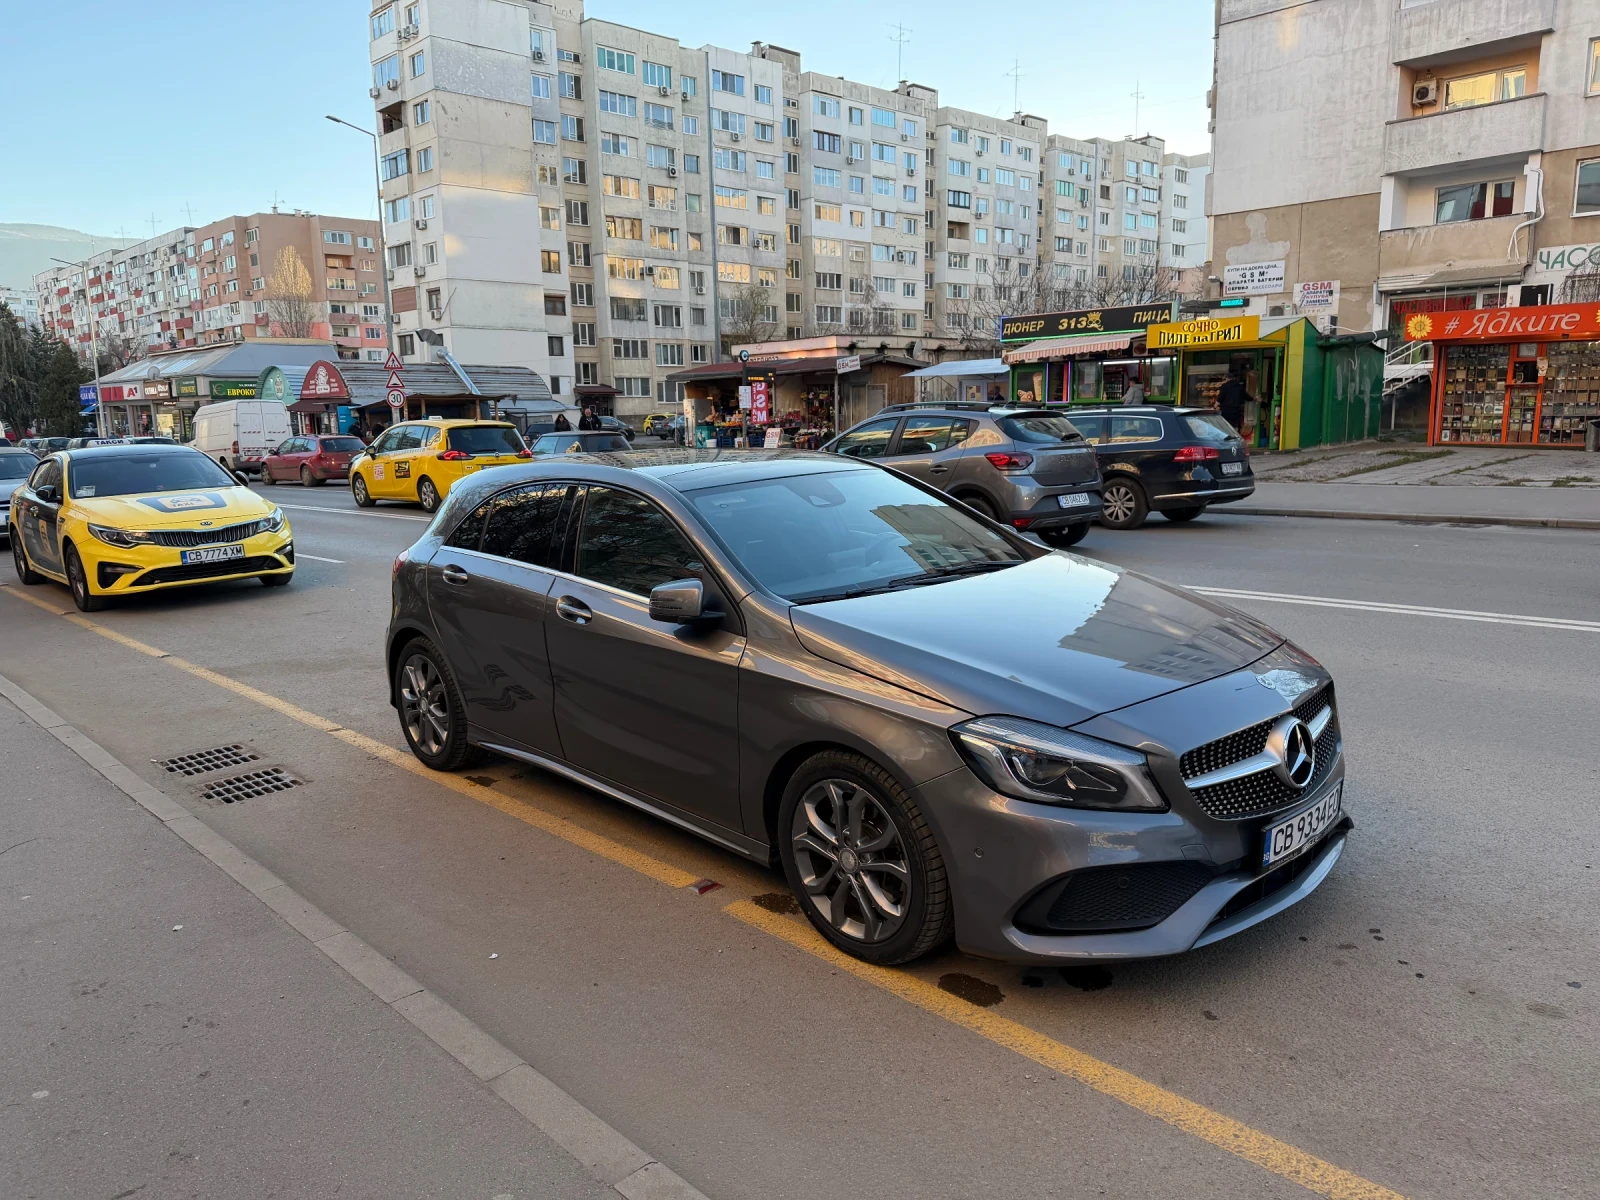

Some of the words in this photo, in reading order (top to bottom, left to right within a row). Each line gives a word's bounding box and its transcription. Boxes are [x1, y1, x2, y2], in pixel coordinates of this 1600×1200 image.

[1302, 282, 1332, 291] GSM
[1133, 309, 1170, 323] ПИЦА
[1002, 320, 1045, 336] ДЮНЕР
[1058, 317, 1087, 330] 313
[1182, 320, 1219, 333] СОЧНО
[1464, 311, 1580, 335] Ядките
[1159, 331, 1190, 345] ПИЛЕ
[1193, 335, 1208, 343] на
[1210, 323, 1241, 342] ГРИЛ
[227, 388, 256, 396] ЕВРОКО
[391, 393, 402, 403] 30
[204, 548, 229, 560] 7774
[1273, 822, 1294, 857] CB
